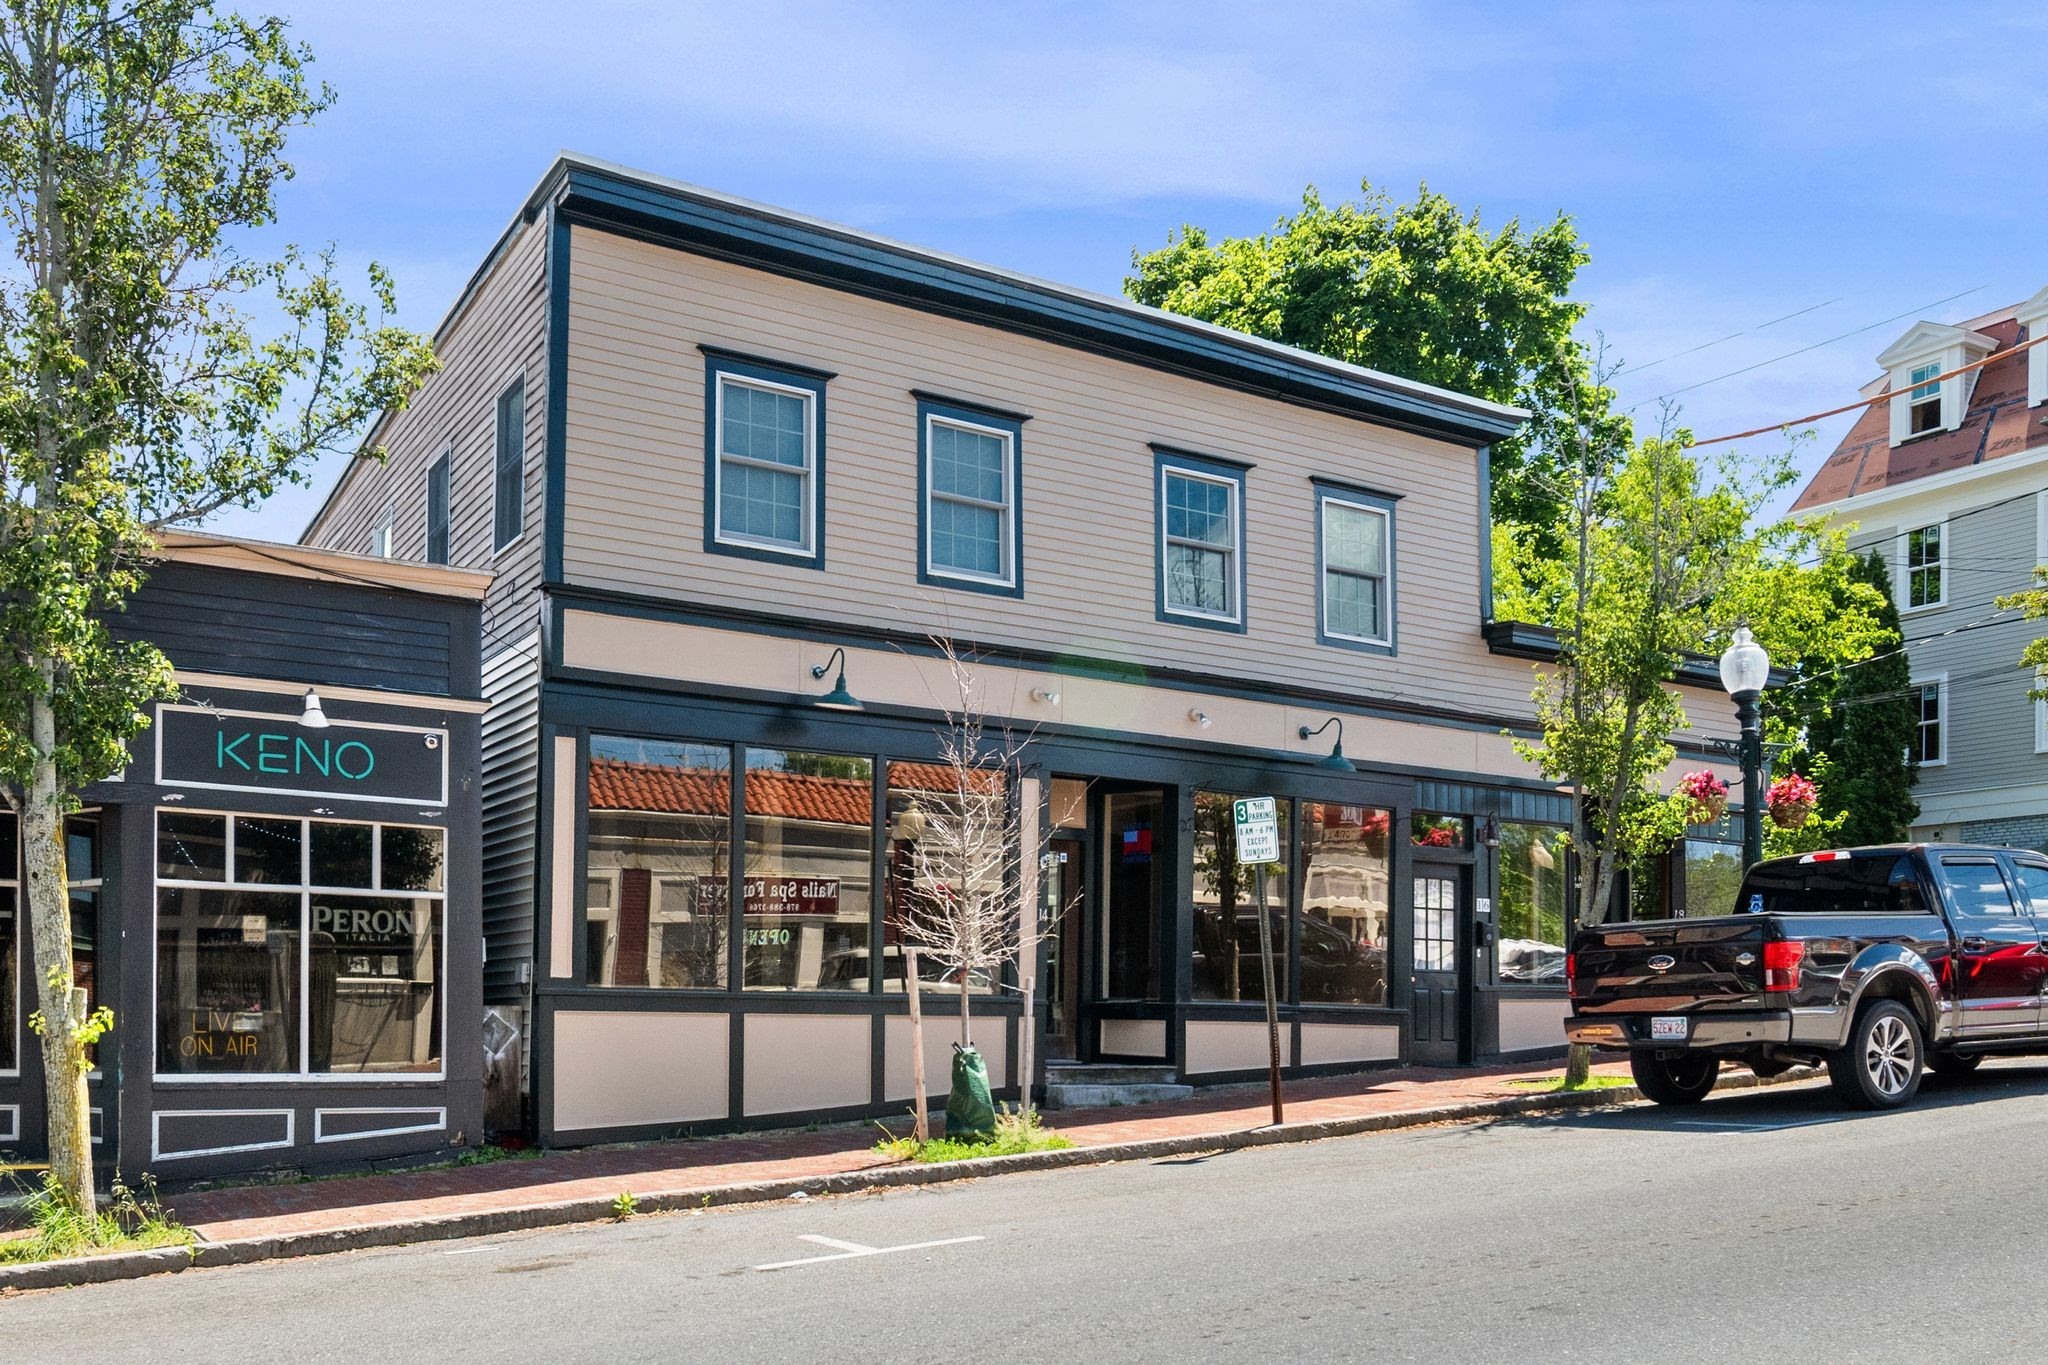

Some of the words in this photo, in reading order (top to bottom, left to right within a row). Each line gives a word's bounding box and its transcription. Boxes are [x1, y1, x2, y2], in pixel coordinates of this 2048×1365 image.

[217, 730, 374, 780] KENO
[1254, 802, 1264, 810] HR
[1237, 805, 1246, 821] 3
[1249, 811, 1273, 820] PARKING
[1240, 828, 1243, 836] 8
[1260, 826, 1263, 834] 6
[1247, 837, 1268, 846] EXCEPT
[1245, 848, 1272, 857] SUNDAYS
[1477, 900, 1490, 911] 16
[1039, 908, 1048, 921] 14
[1674, 909, 1685, 919] 18
[346, 933, 391, 942] ITALIA
[193, 1011, 247, 1033] LIVE
[1675, 1023, 1685, 1034] 22
[181, 1036, 213, 1056] ON
[226, 1036, 257, 1056] AIR
